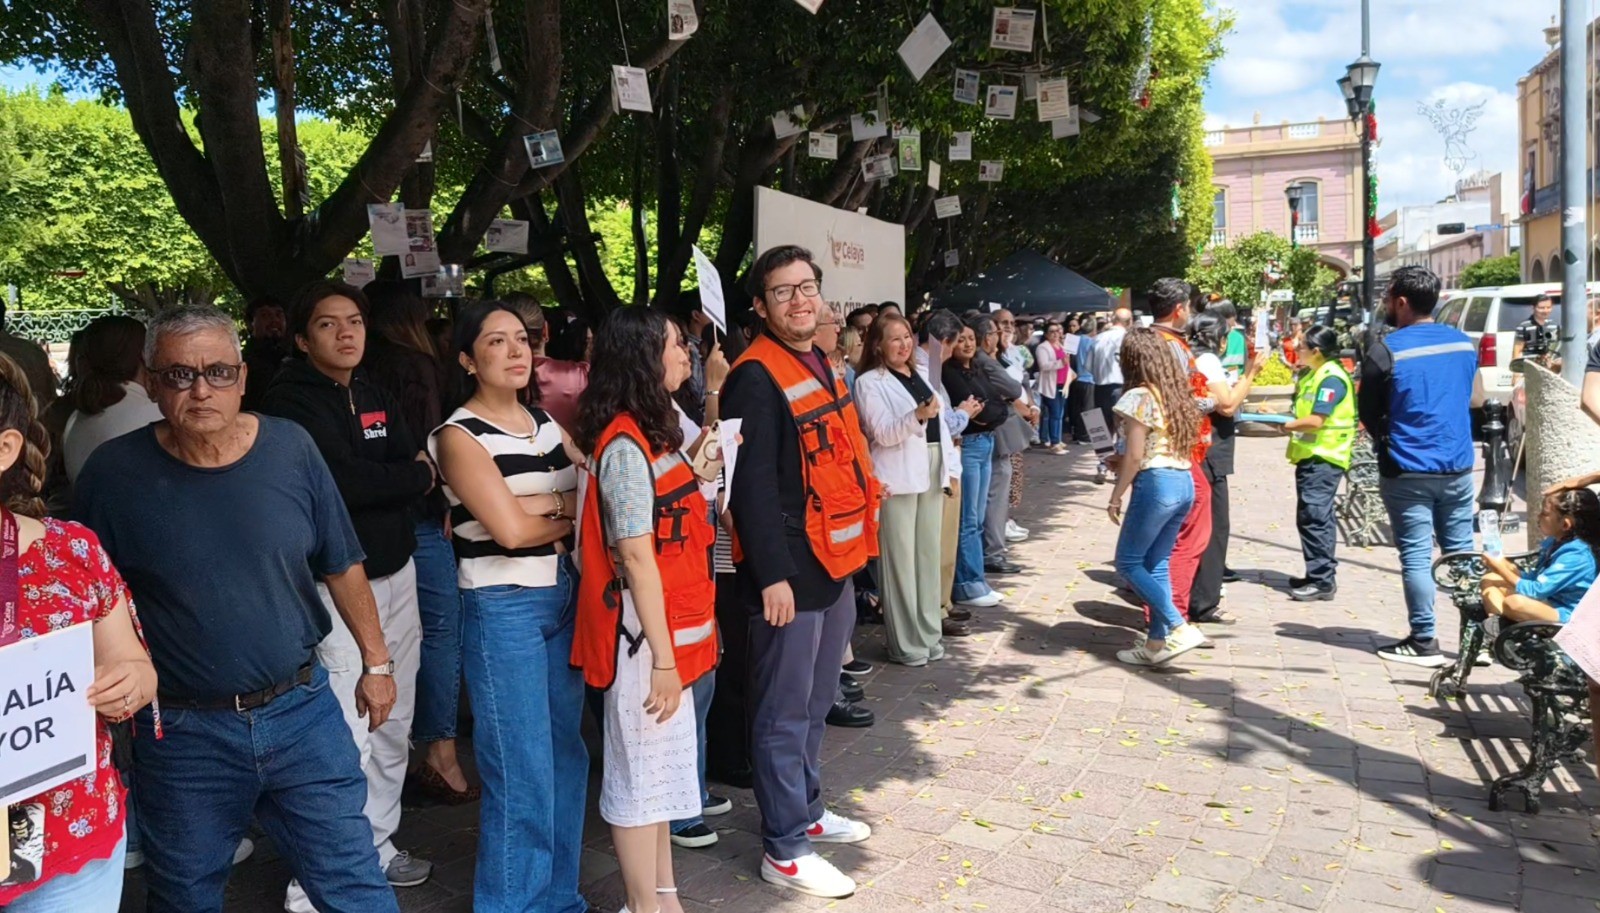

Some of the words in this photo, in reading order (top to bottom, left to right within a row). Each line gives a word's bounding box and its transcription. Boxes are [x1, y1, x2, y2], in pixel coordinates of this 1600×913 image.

[842, 241, 864, 263] Celaya
[363, 426, 387, 439] Shred
[3, 602, 12, 622] Celaya
[0, 670, 76, 716] ALÍA
